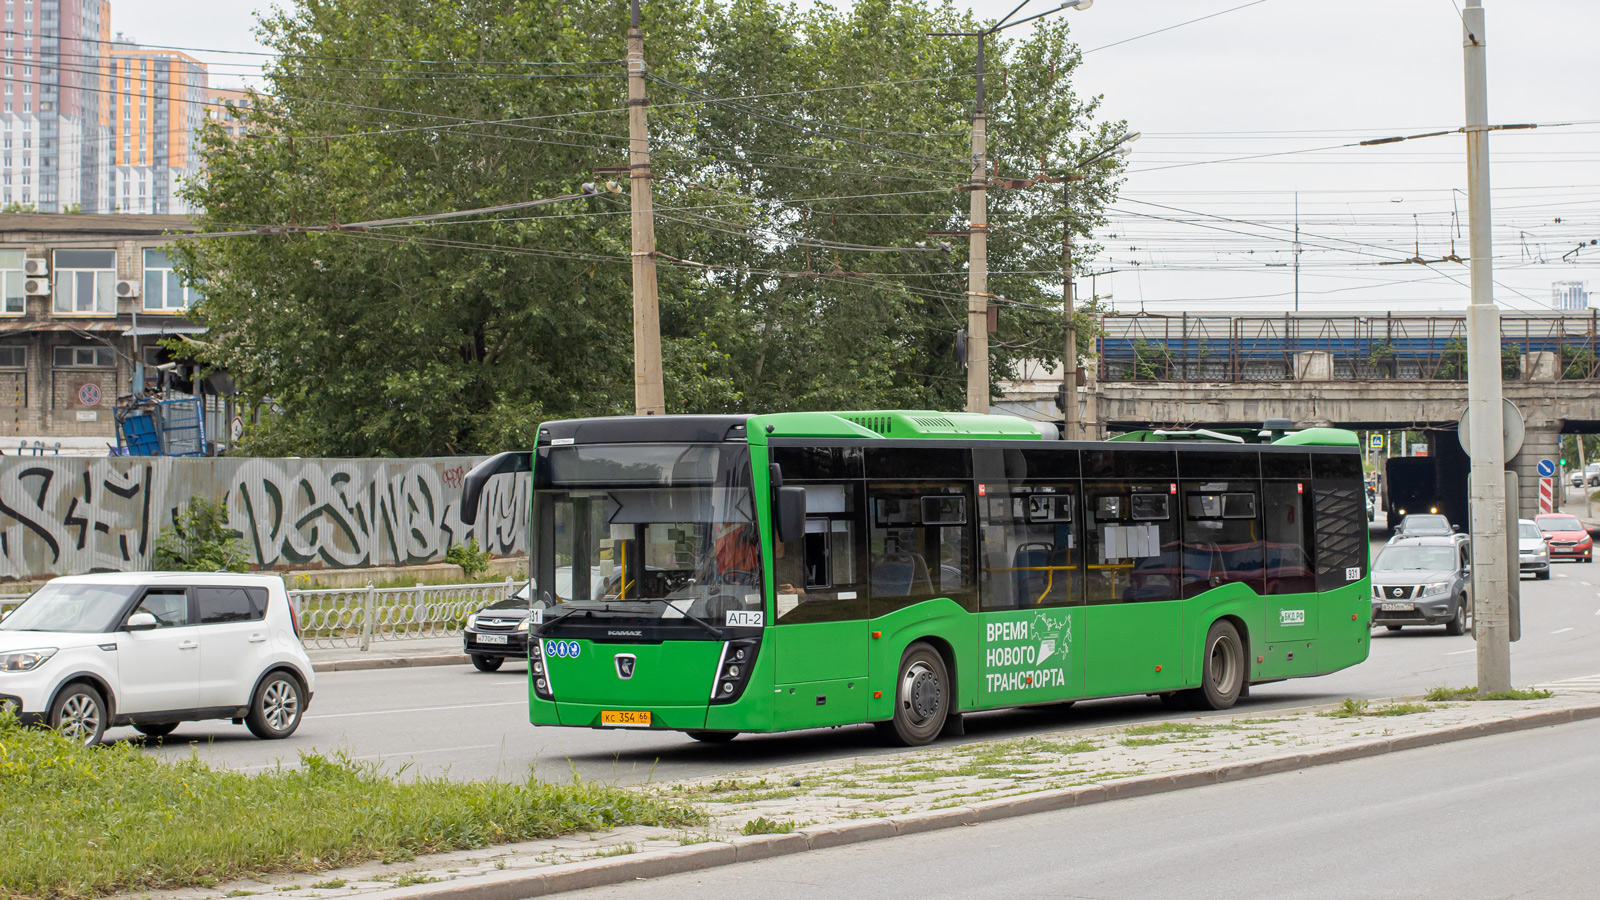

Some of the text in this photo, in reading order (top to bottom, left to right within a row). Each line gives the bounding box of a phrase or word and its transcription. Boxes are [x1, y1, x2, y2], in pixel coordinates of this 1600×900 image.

[1348, 569, 1358, 579] 931
[529, 610, 538, 622] 31
[728, 612, 761, 625] АП-2
[1284, 611, 1304, 621] БКД.РФ
[986, 621, 1028, 642] ВРЕМЯ
[986, 645, 1035, 667] НОВОГО
[986, 668, 1065, 693] ТРАНСПОРТА
[605, 714, 616, 722] КС
[619, 712, 635, 722] 354
